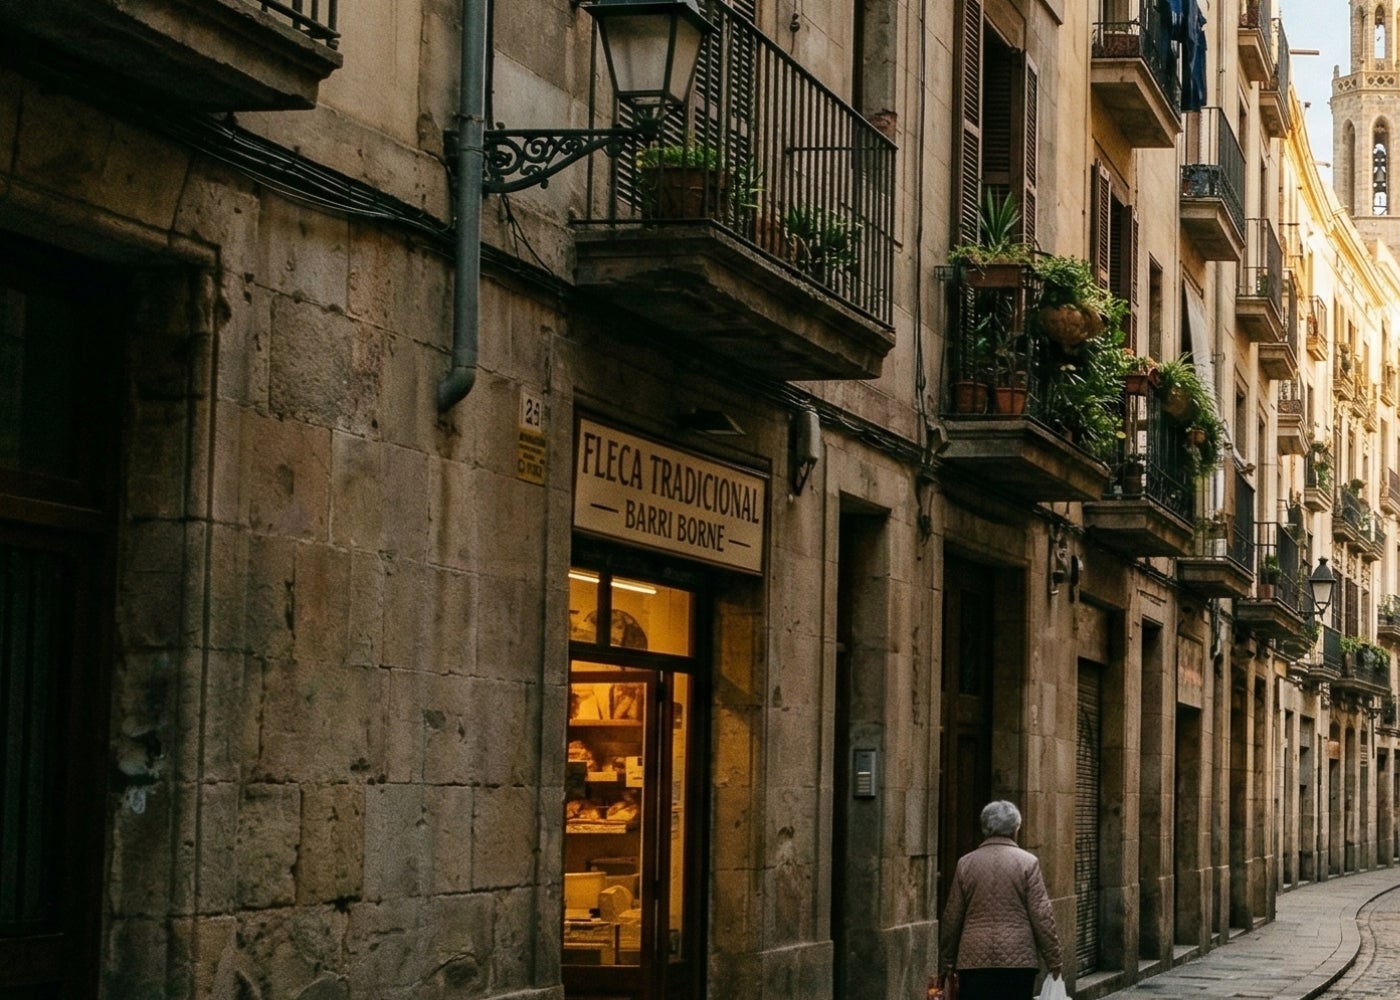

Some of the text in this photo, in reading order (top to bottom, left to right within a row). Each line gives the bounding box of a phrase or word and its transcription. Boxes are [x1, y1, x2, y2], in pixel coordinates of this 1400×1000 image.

[582, 432, 760, 525] FLECA TRADICIONAL
[625, 500, 725, 552] BARRI BORNE
